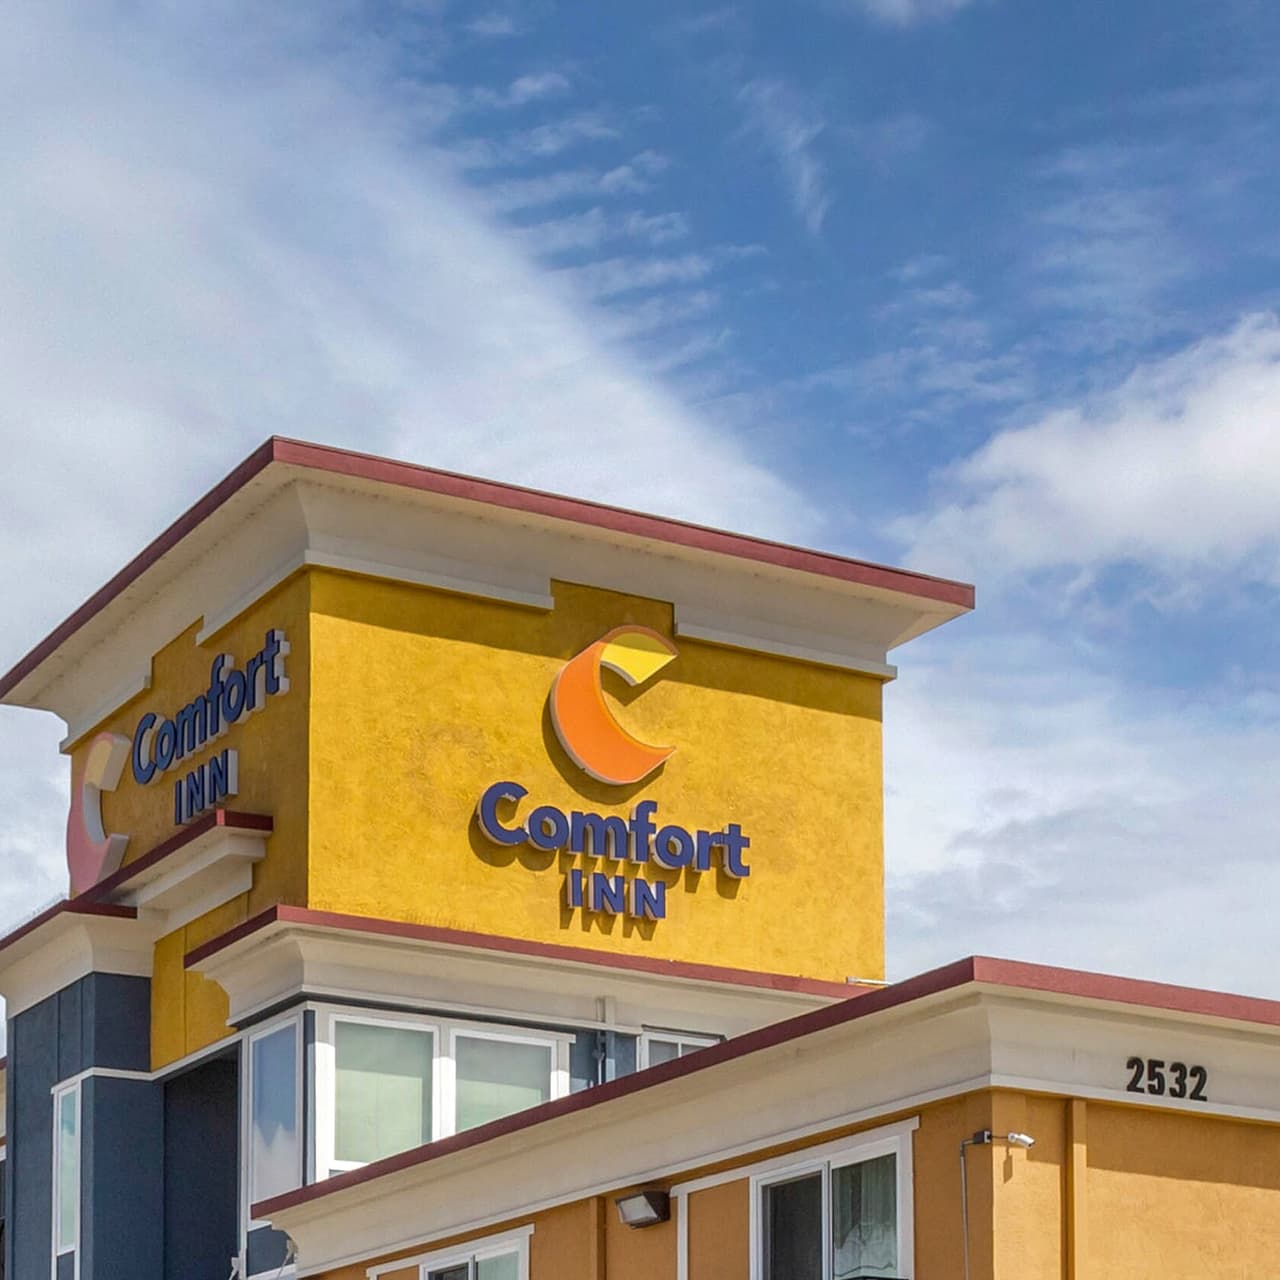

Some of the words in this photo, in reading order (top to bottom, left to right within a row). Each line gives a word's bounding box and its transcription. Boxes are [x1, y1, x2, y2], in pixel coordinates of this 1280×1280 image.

[131, 628, 286, 785] Comfort
[175, 748, 236, 825] INN
[477, 781, 750, 877] Comfort
[567, 868, 666, 920] INN
[1126, 1056, 1208, 1102] 2532
